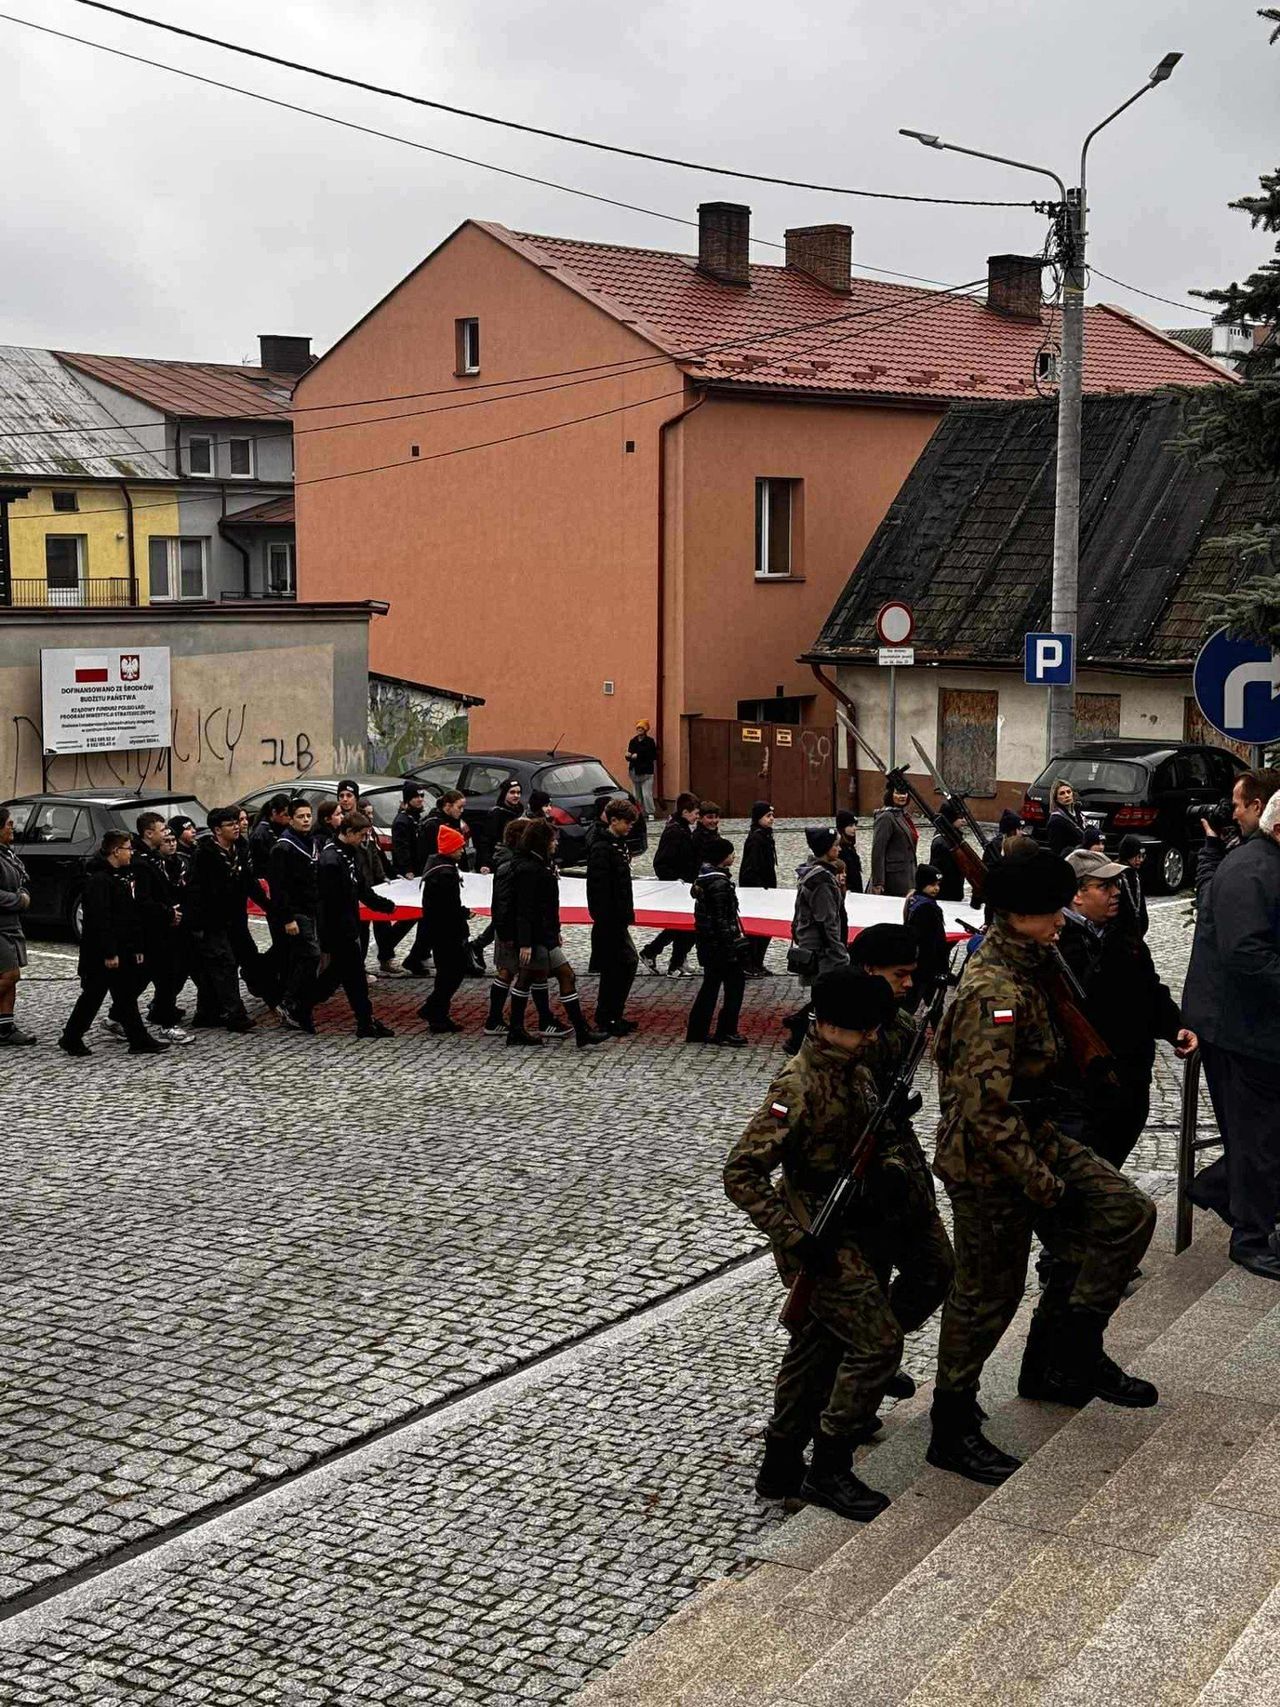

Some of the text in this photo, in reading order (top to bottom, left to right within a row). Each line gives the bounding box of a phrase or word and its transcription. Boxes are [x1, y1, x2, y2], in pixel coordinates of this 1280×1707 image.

[1036, 639, 1063, 679] P
[61, 686, 115, 694] DOFINANSOWANO
[123, 684, 154, 692] ŚRODKÓW
[106, 693, 136, 701] PAŃSTWA
